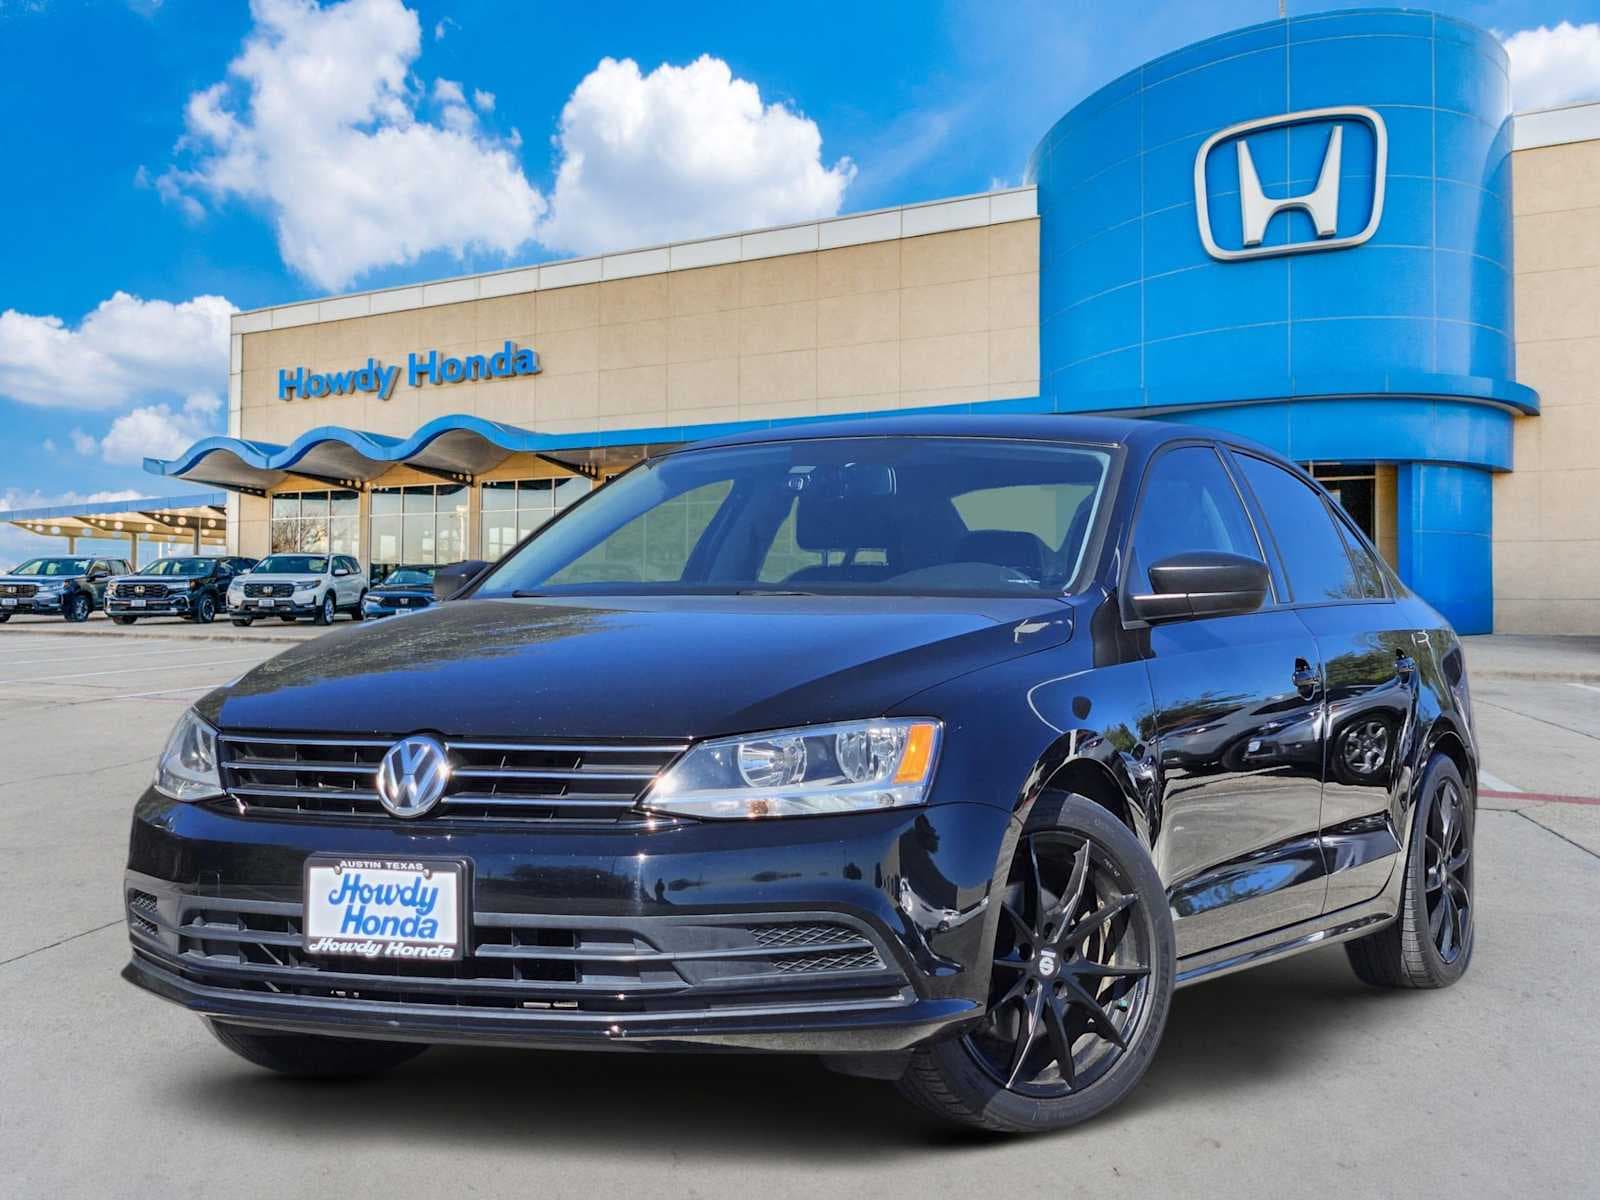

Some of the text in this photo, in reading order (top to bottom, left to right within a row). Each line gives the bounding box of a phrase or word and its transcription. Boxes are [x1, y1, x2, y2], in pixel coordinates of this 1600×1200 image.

[278, 340, 541, 400] Howdy Honda
[339, 860, 425, 871] AUSTIN TEXAS
[328, 873, 439, 916] Howdy
[340, 904, 439, 939] Honda
[308, 937, 456, 958] Howdy Honda
